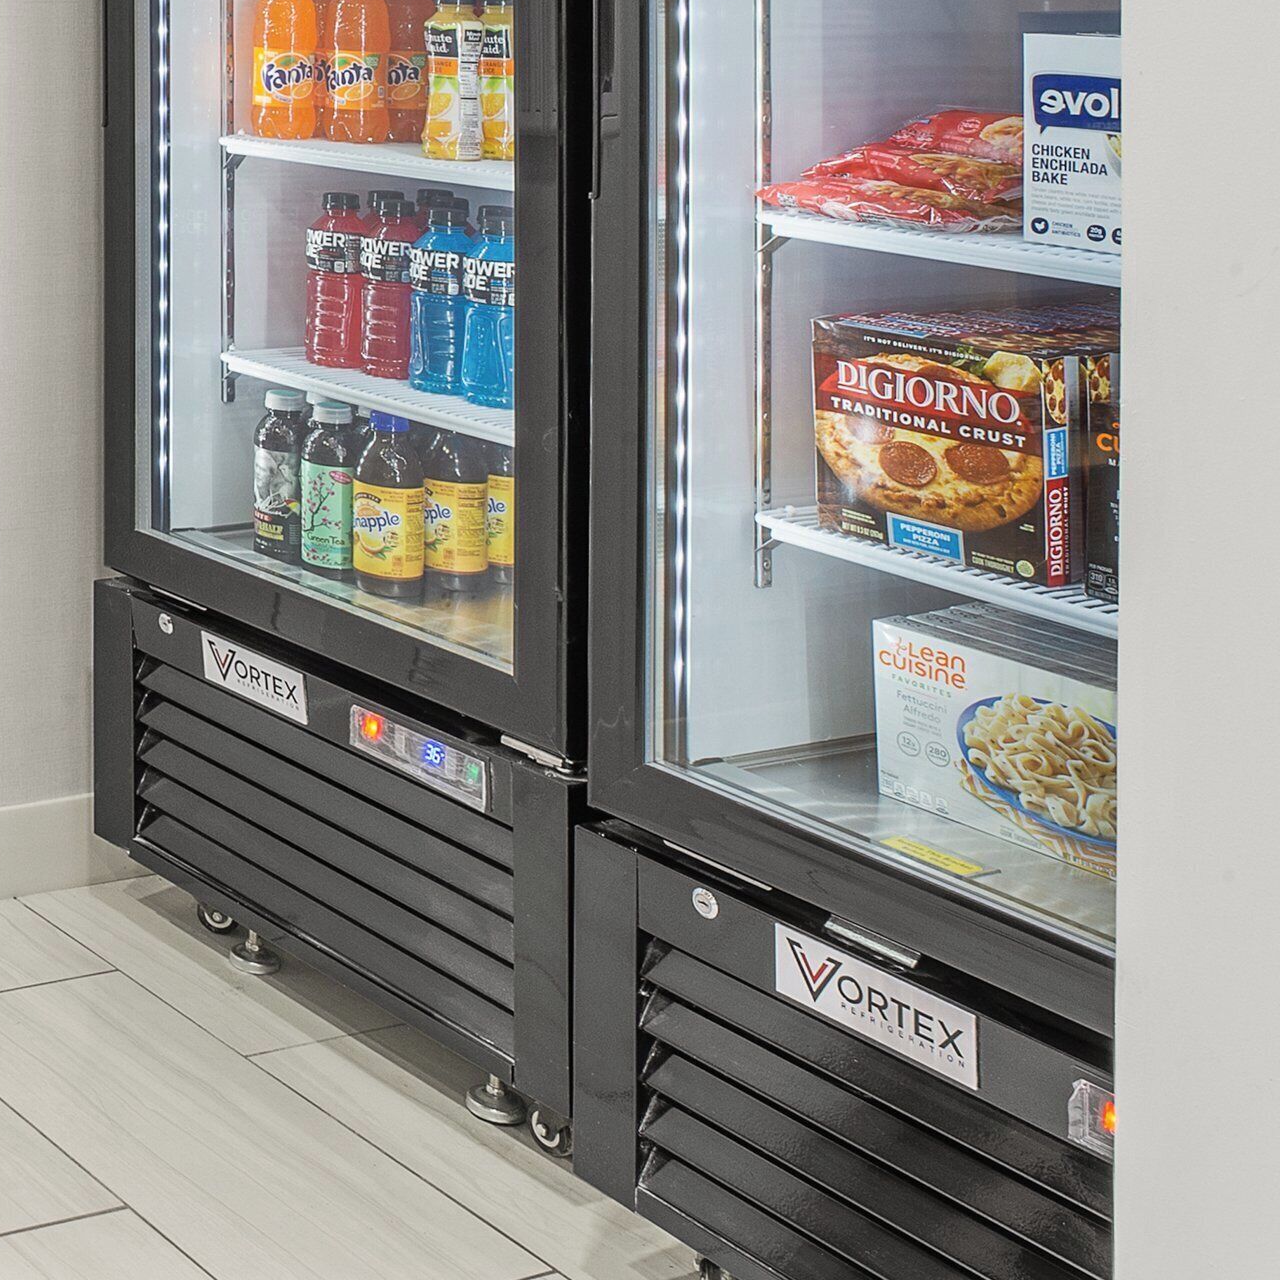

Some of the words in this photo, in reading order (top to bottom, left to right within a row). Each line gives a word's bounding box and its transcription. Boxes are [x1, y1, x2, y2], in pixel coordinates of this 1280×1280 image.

[264, 63, 313, 91] Fanta
[1031, 144, 1090, 160] CHICKEN
[1031, 157, 1109, 176] ENCHILADA
[1031, 171, 1068, 186] BAKE
[831, 396, 951, 435] TRADITIONAL
[959, 424, 1026, 448] CRUST
[306, 532, 330, 545] Green
[330, 535, 345, 545] Tea
[900, 523, 950, 542] PEPPERONI
[912, 533, 940, 548] PIZZA
[1049, 489, 1063, 577] DIGIORNO
[908, 641, 966, 673] Lean
[207, 639, 299, 705] VORTEX
[891, 673, 952, 698] FAVORITES
[896, 689, 948, 715] Fettuccini
[903, 703, 940, 723] Alfredo
[785, 936, 965, 1059] VORTEX
[840, 1001, 966, 1069] REFRIGERATION
